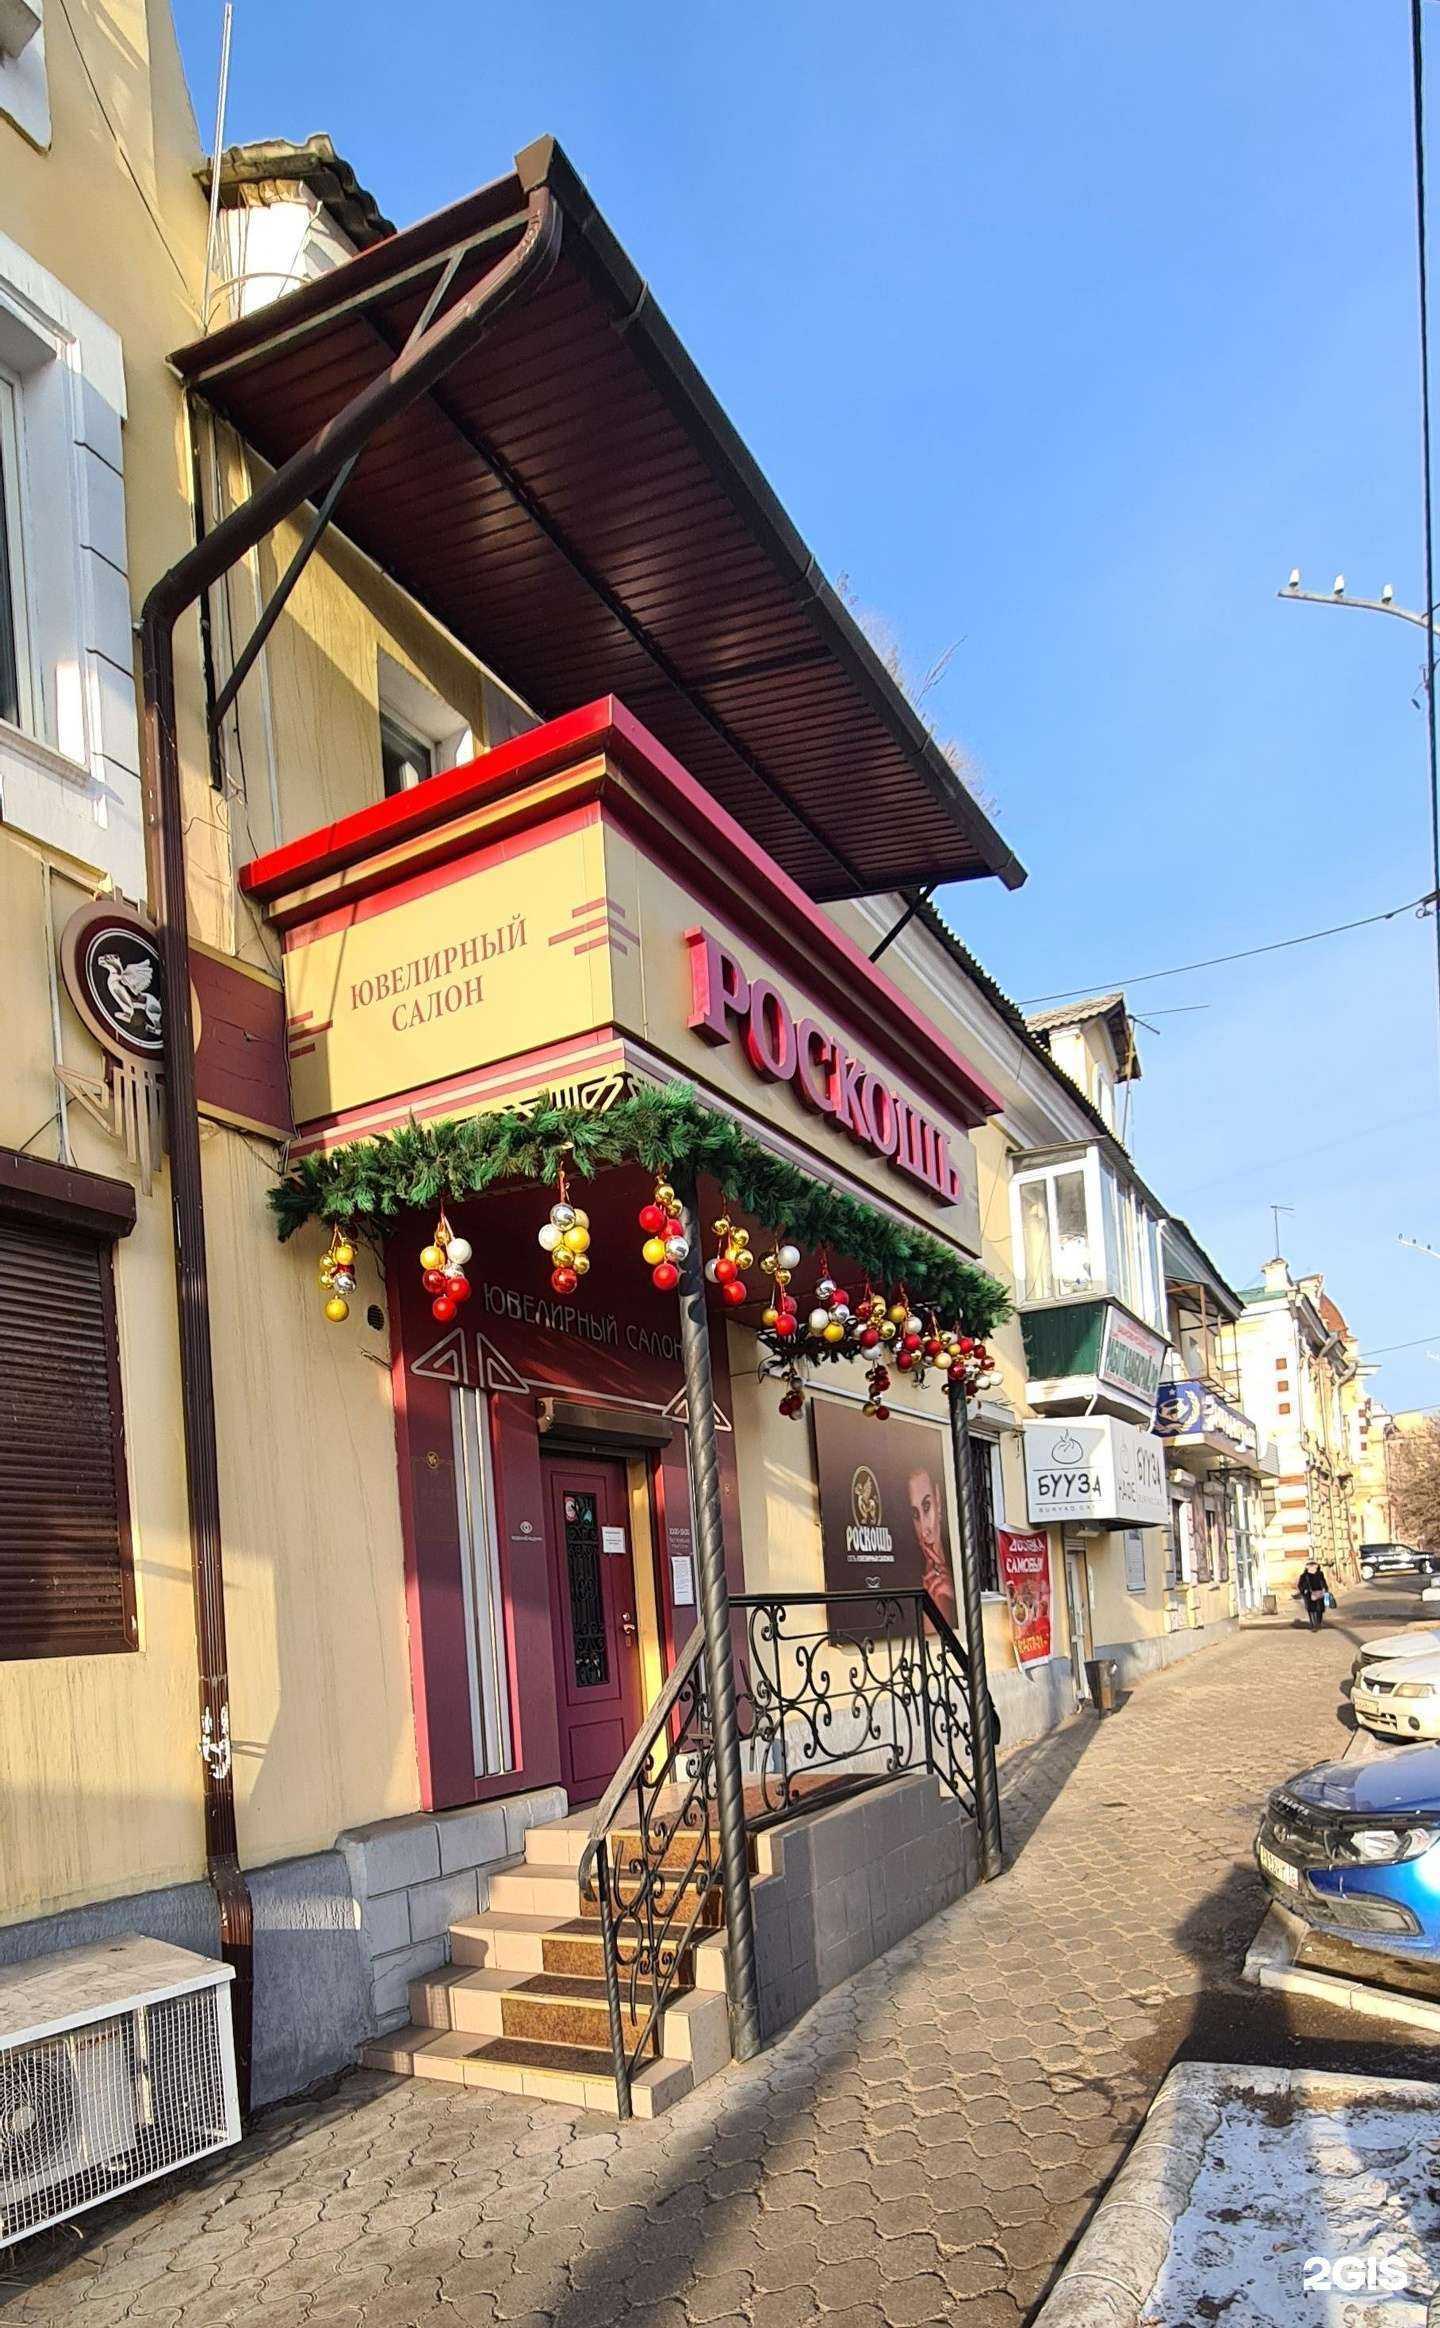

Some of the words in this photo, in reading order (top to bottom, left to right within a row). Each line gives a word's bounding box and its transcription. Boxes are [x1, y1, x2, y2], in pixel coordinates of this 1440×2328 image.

[350, 914, 528, 1011] ЮВЕЛИРНЫЙ
[391, 975, 486, 1033] САЛОН
[683, 925, 961, 1208] РОСКОШЬ
[484, 1282, 619, 1346] ЮВЕЛИРНЫЙ
[1038, 1473, 1102, 1498] БУУЗА
[846, 1525, 893, 1552] РОСКОШЬ
